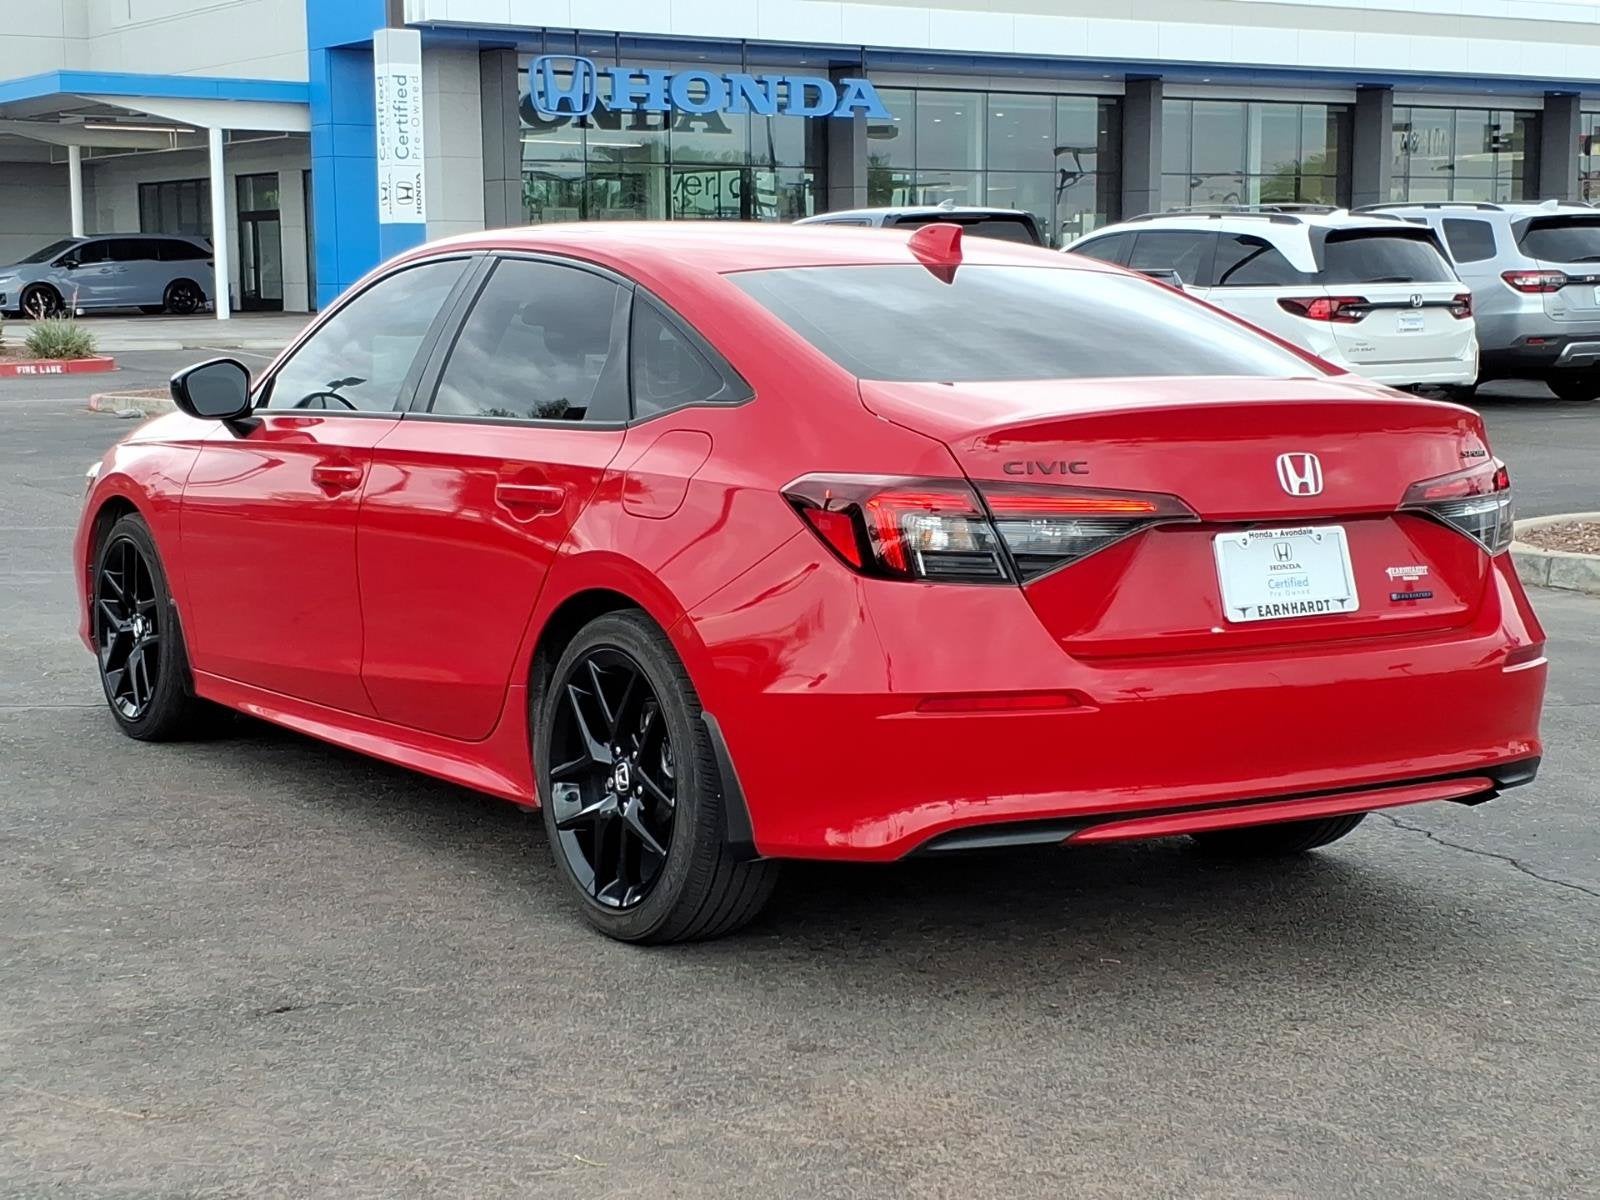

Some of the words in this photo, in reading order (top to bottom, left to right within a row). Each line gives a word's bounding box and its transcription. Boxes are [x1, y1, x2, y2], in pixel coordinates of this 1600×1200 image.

[606, 66, 892, 119] HONDA
[392, 74, 409, 160] Certified
[410, 76, 421, 159] Pre-Owned
[16, 365, 37, 374] FIRE
[1003, 461, 1090, 475] CIVIC
[1280, 528, 1313, 536] Avondale
[1267, 576, 1310, 589] Certified
[1257, 599, 1331, 617] EARNHARDT
